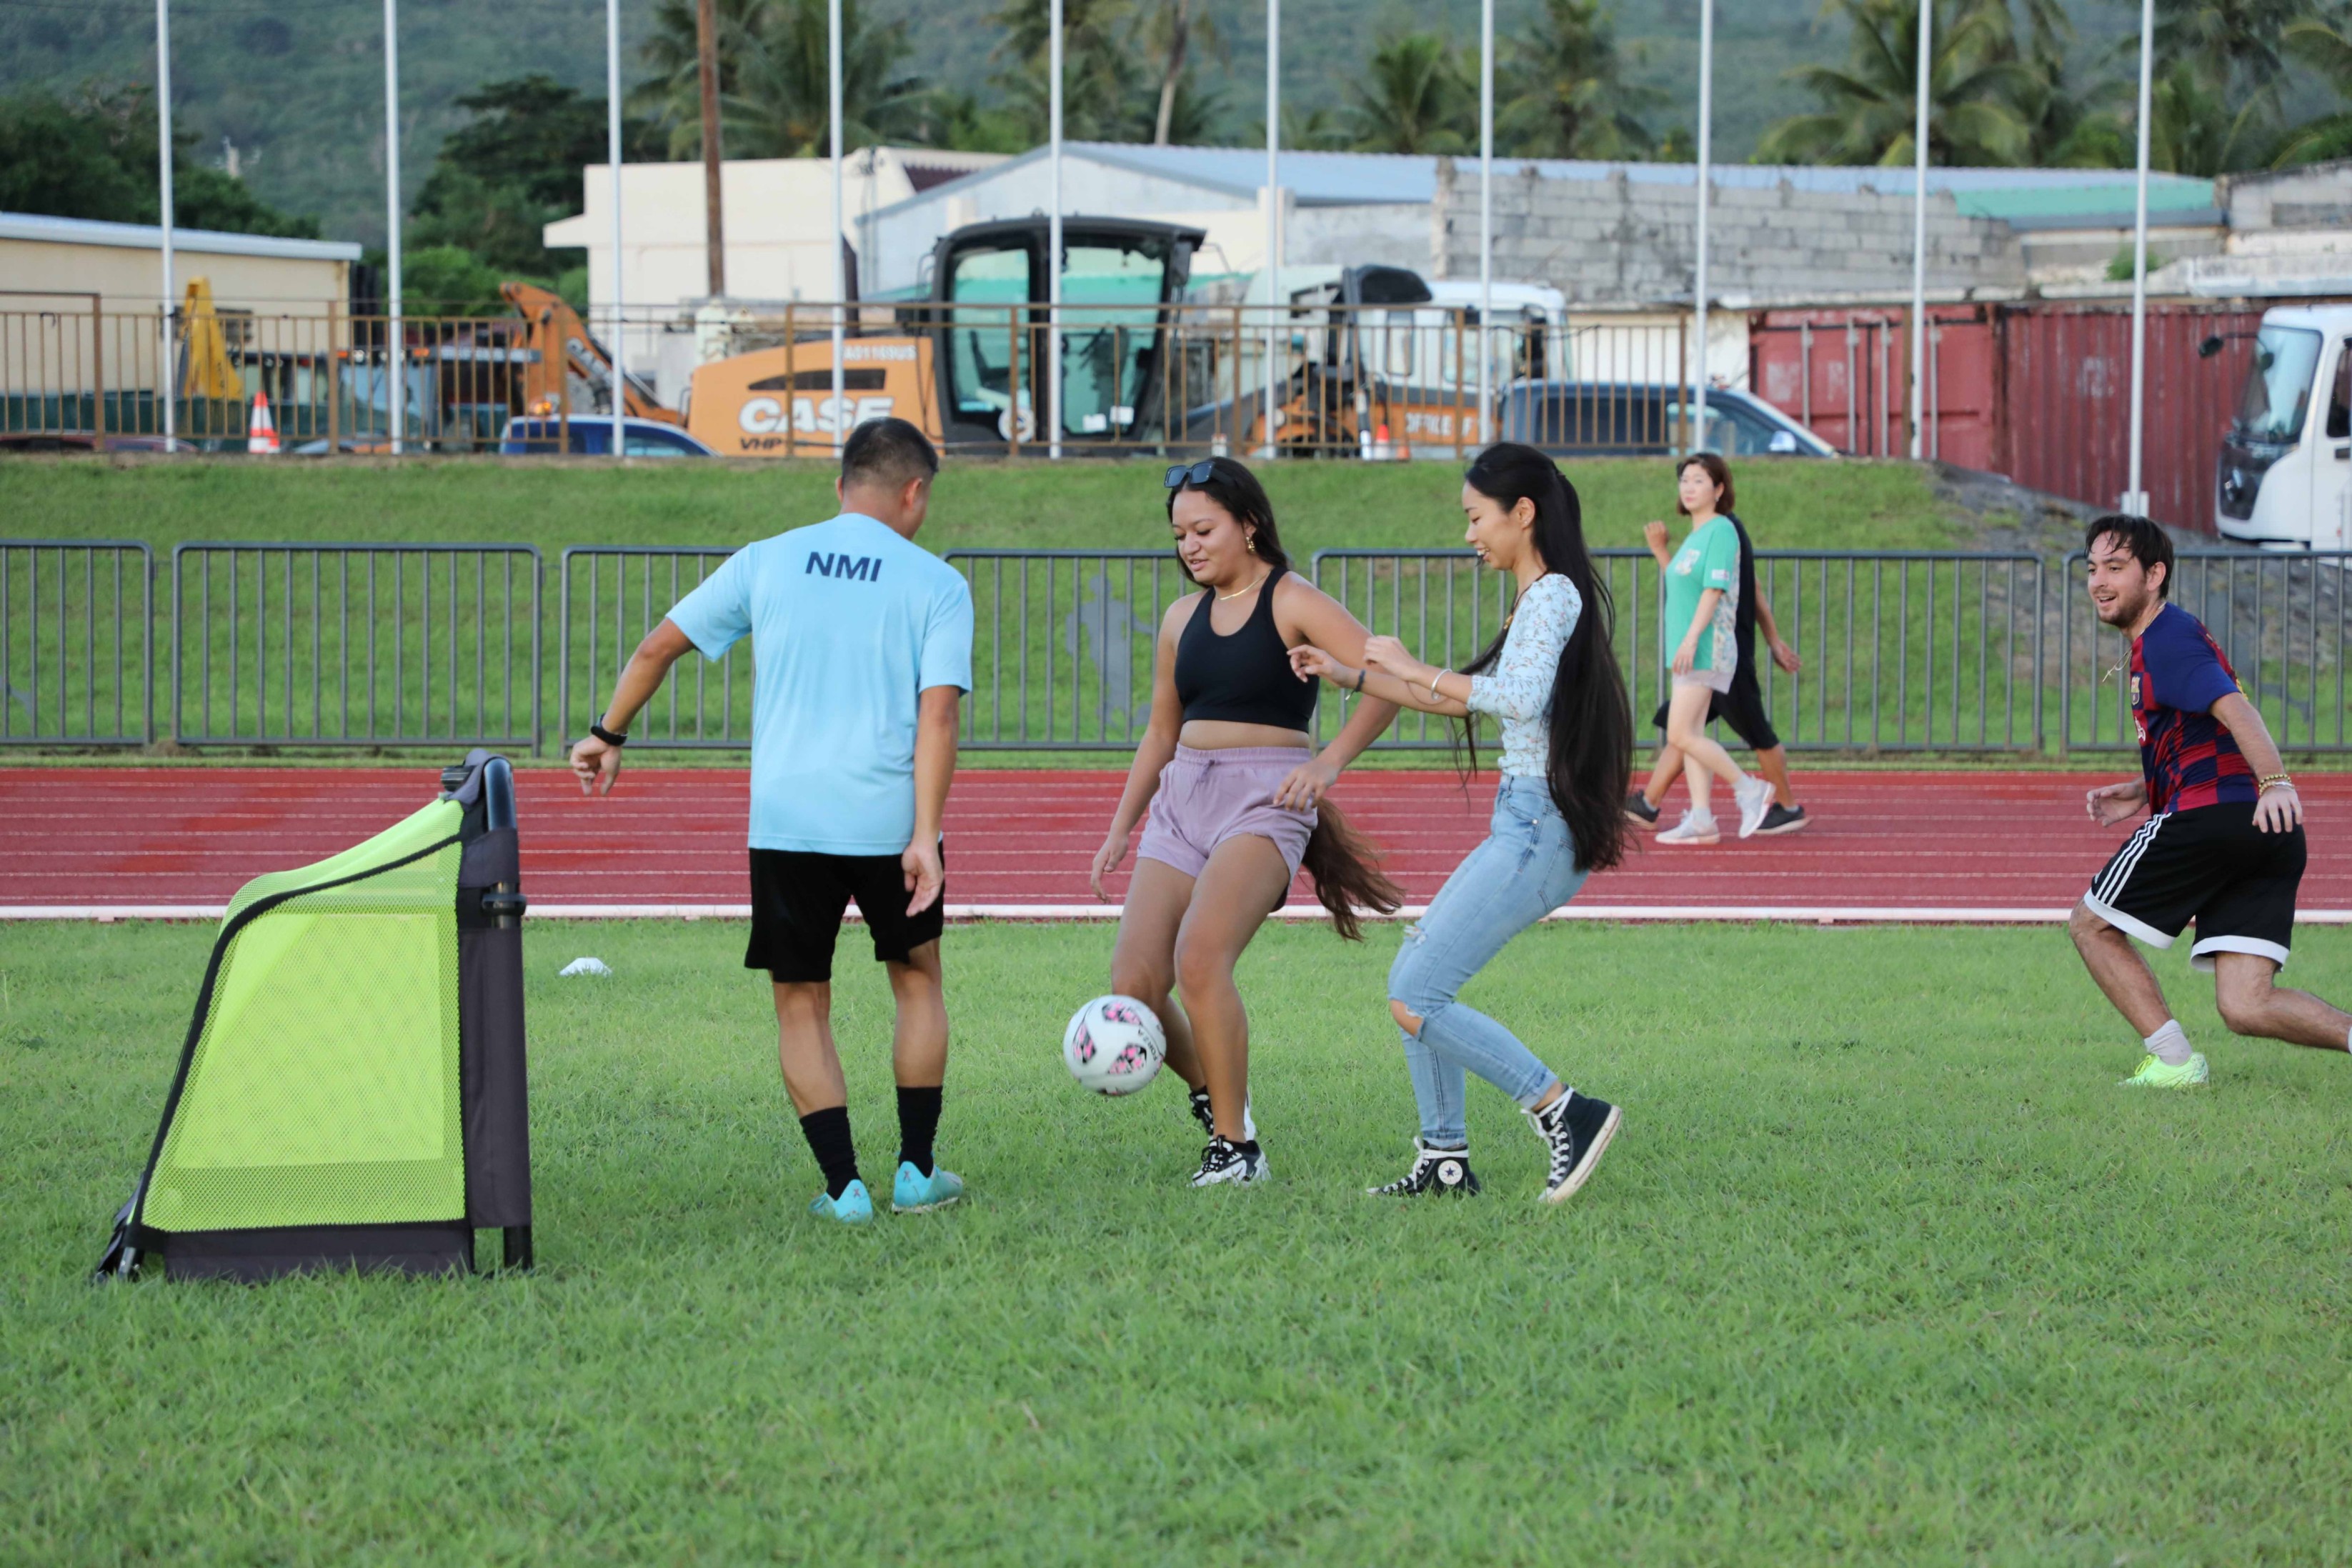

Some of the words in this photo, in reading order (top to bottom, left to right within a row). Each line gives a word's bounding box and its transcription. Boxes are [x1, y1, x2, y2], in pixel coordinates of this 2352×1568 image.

[739, 396, 893, 433] CASE
[740, 438, 782, 450] VHP
[804, 551, 882, 581] NMI
